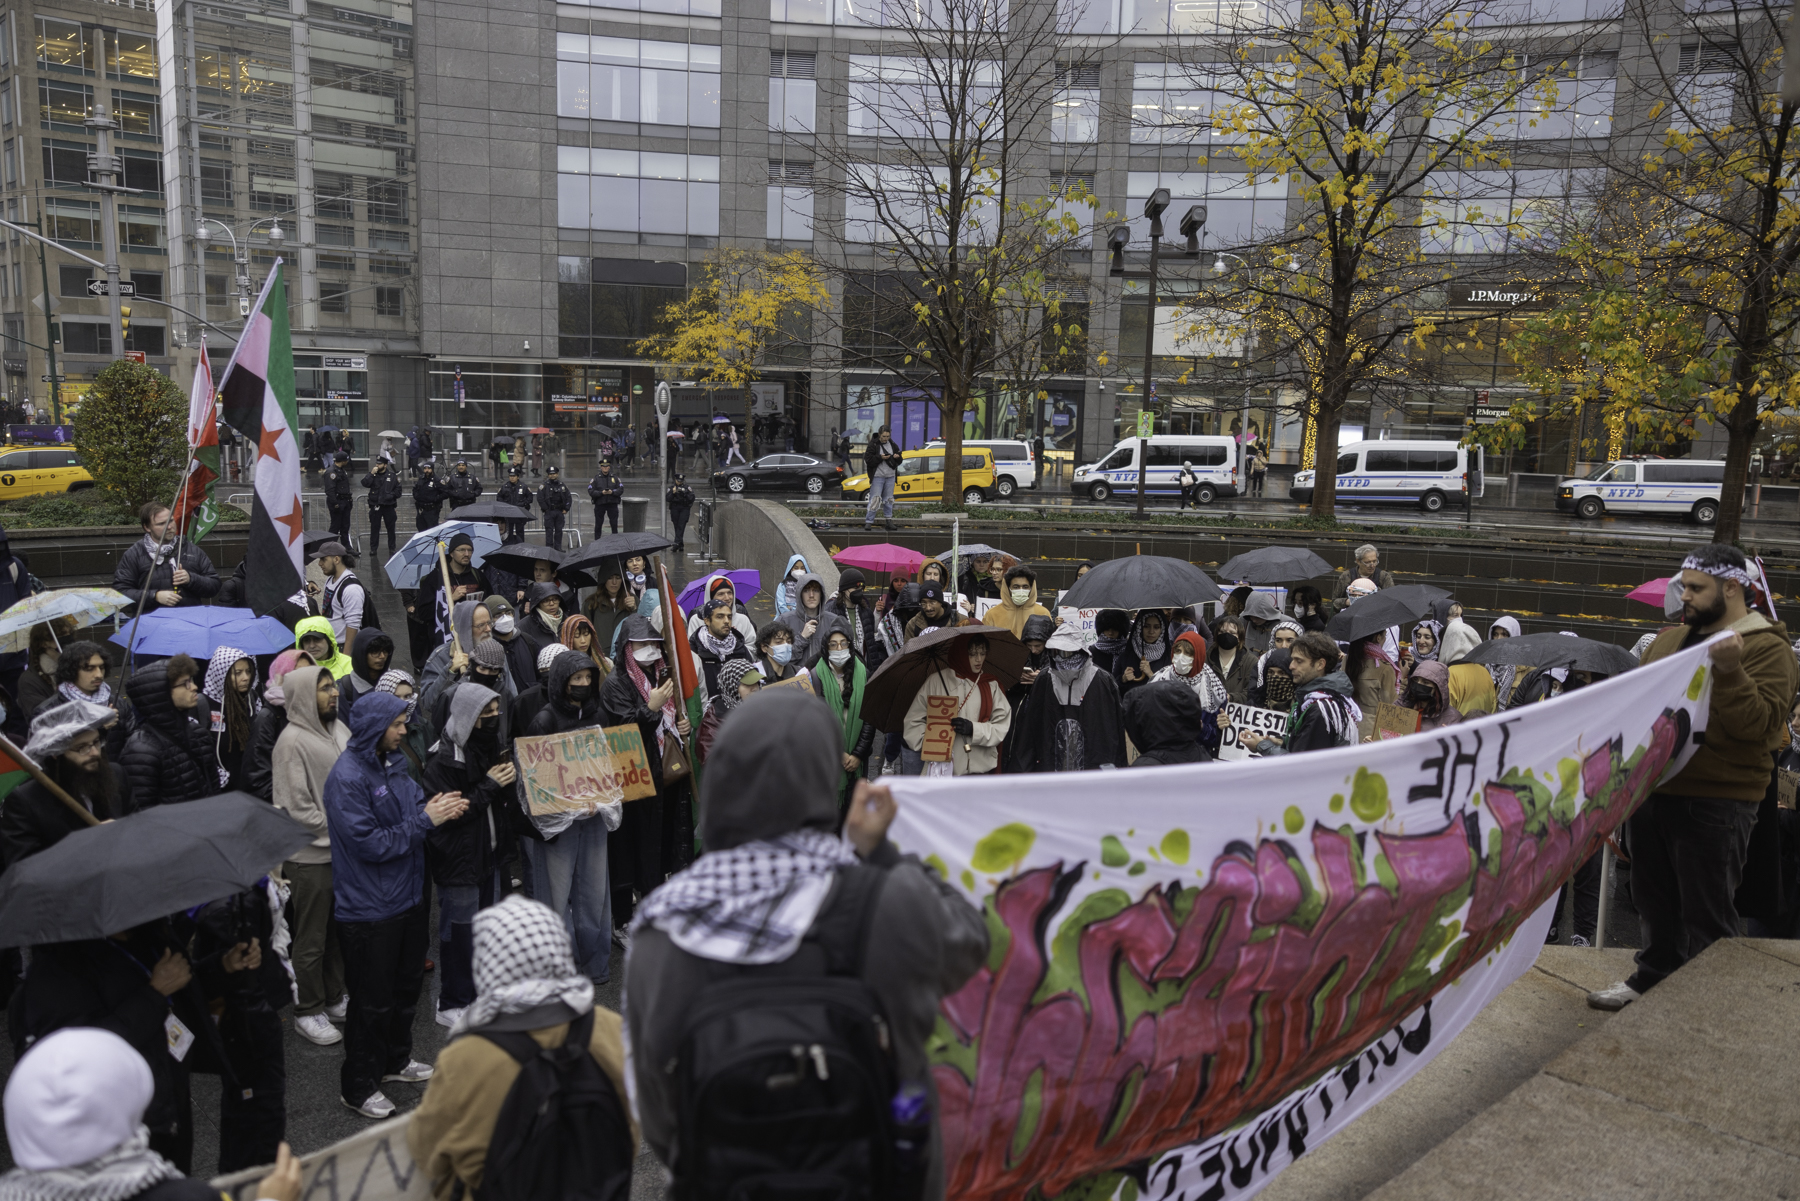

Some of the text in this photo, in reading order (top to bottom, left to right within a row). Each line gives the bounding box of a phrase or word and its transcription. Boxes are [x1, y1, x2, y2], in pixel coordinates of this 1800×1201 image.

[1467, 290, 1537, 306] J.P.Morgan
[1114, 473, 1139, 482] NYP
[1337, 479, 1371, 488] NYPD
[1607, 488, 1645, 498] NYPD
[556, 758, 651, 800] Genocide
